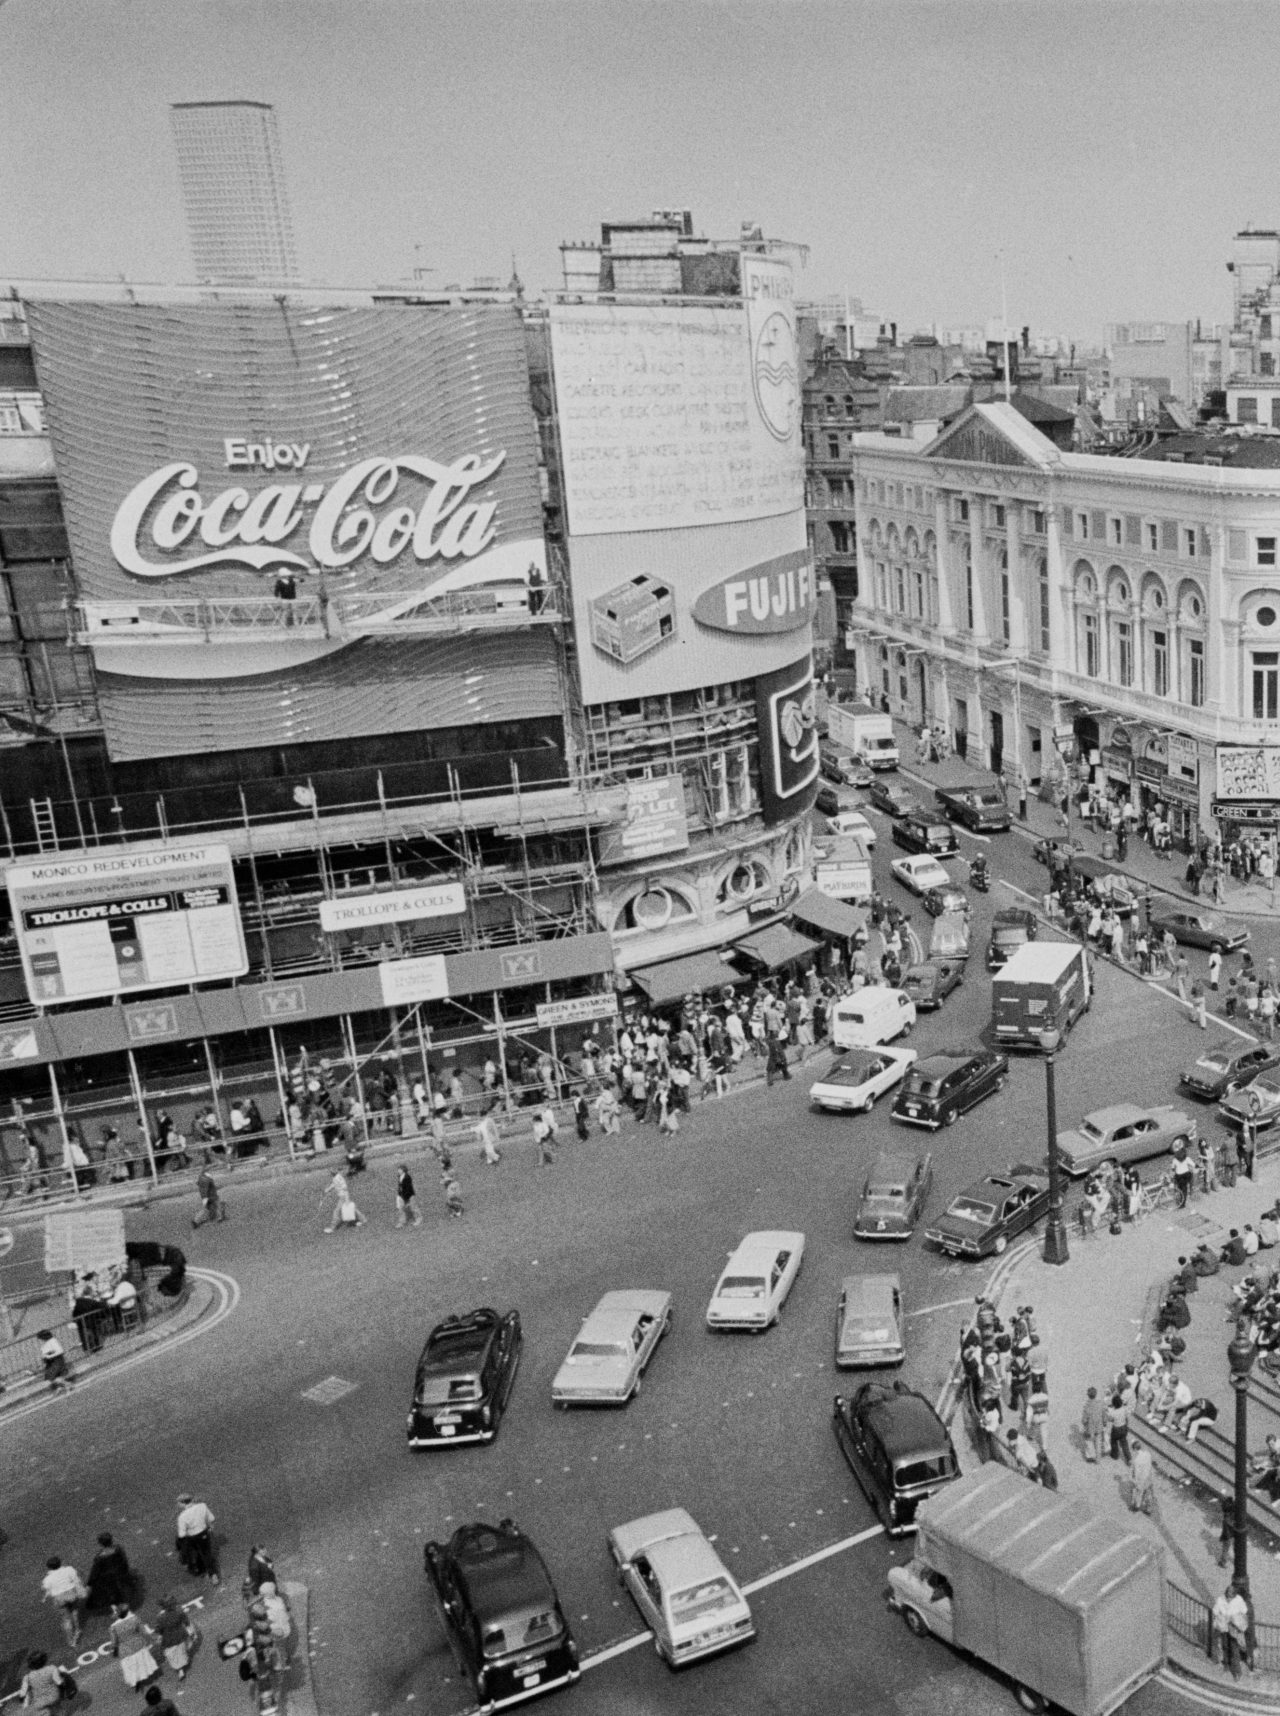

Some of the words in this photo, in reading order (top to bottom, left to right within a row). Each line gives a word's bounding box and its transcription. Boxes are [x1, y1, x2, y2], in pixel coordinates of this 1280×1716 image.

[224, 438, 310, 468] Enjoy
[110, 450, 508, 577] Coca-Cola
[725, 571, 796, 626] FUJI
[1217, 807, 1248, 817] GREEN
[32, 861, 88, 879] MONICO
[94, 850, 207, 873] REDEVELOPMENT
[31, 904, 108, 926] TROLLOPE
[109, 903, 121, 916] &
[121, 897, 168, 914] COLLS
[333, 902, 400, 921] TROLLOPE
[402, 901, 412, 911] &
[414, 894, 455, 909] COLLS
